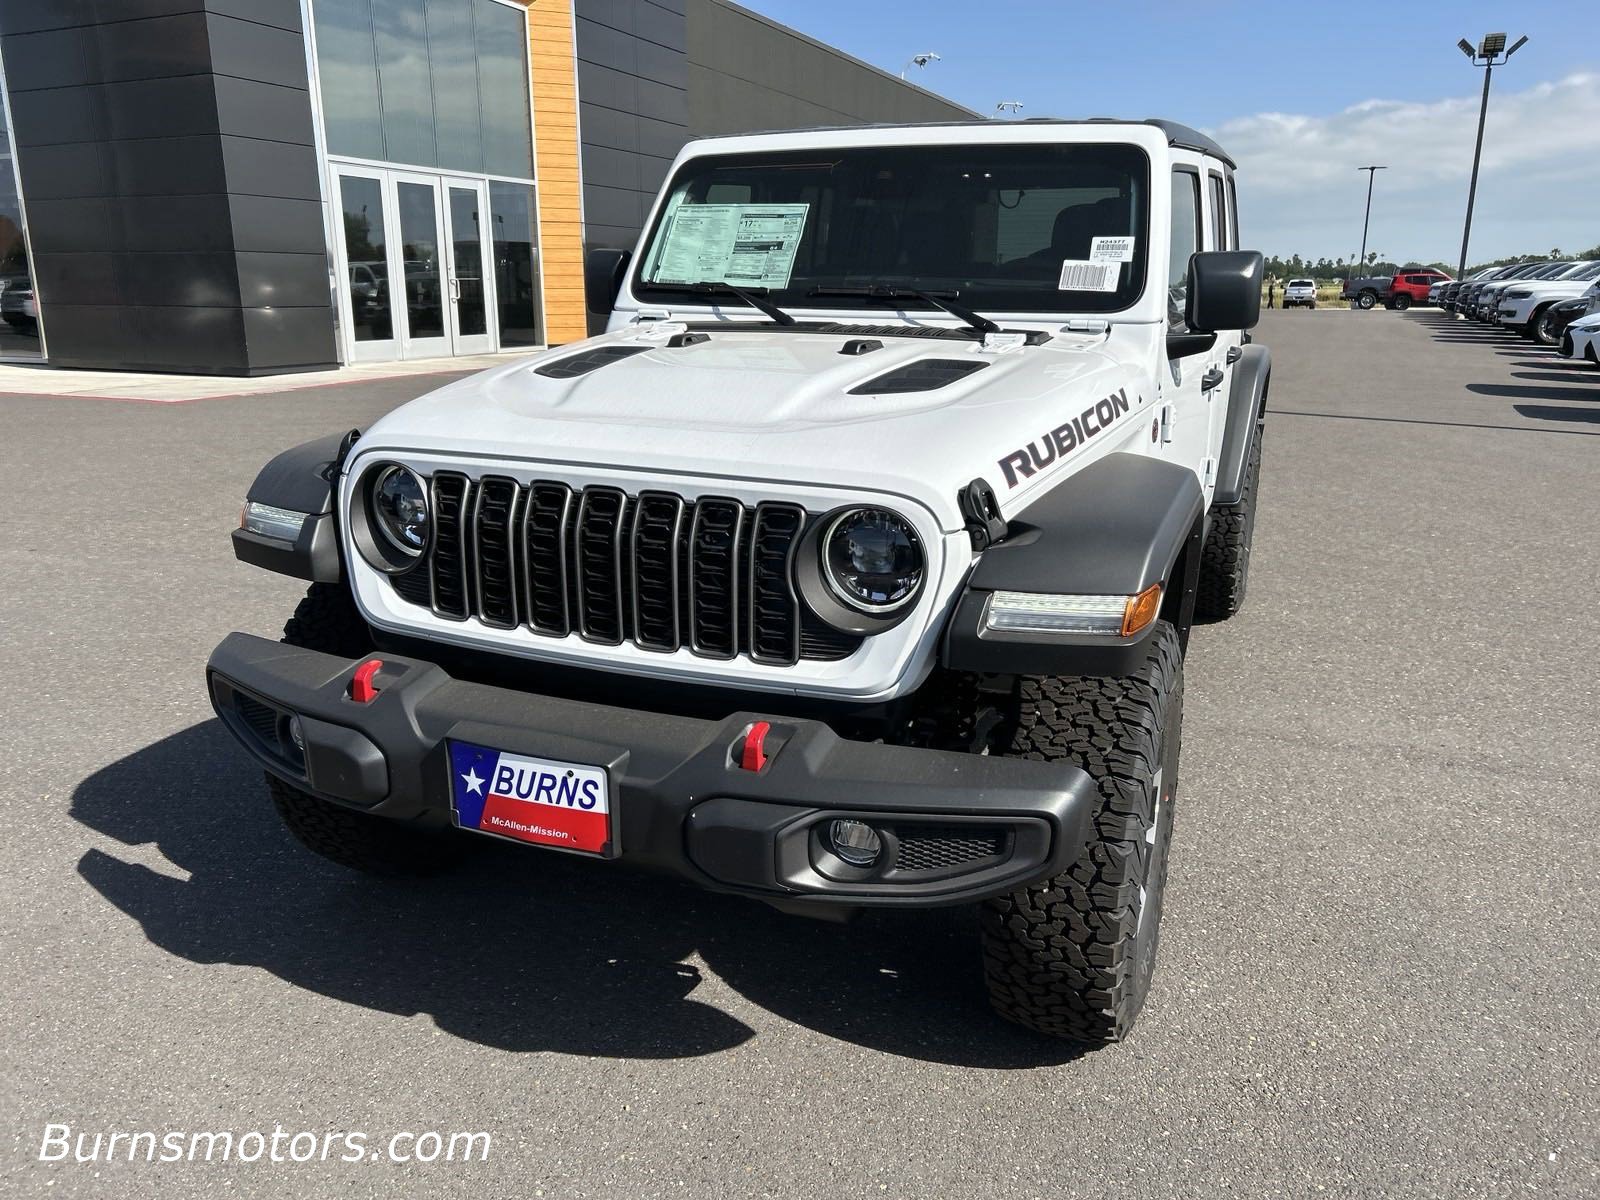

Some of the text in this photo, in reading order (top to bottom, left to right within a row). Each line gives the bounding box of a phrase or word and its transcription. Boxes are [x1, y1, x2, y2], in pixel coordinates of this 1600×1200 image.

[997, 387, 1130, 490] RUBICON
[494, 765, 599, 810] BURNS
[491, 816, 569, 839] McAllen-Mission
